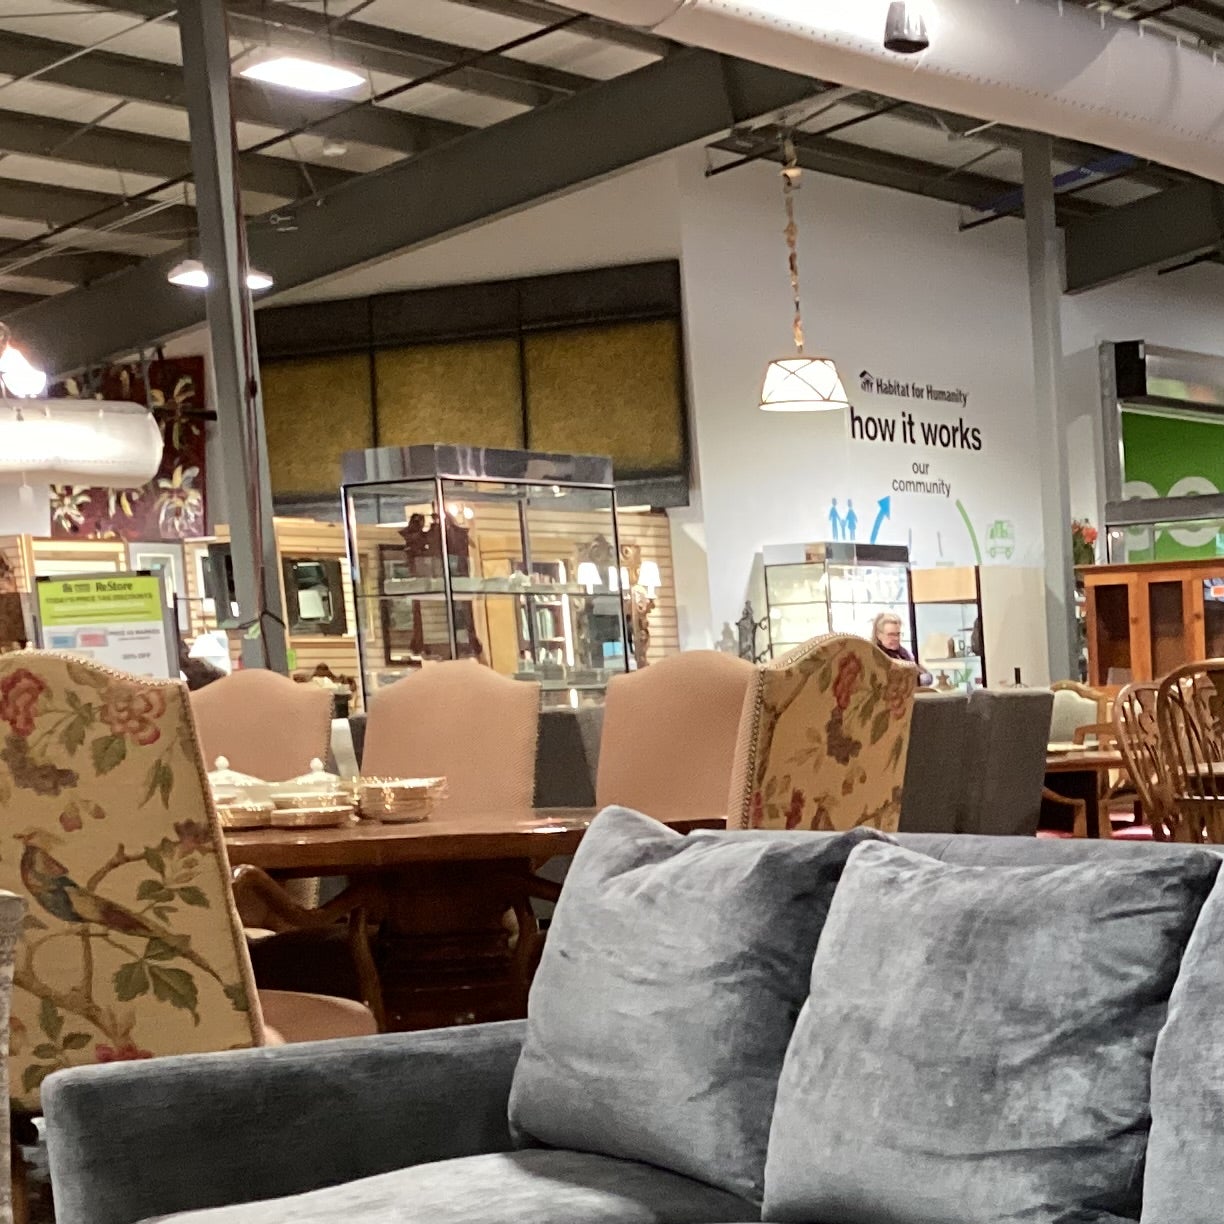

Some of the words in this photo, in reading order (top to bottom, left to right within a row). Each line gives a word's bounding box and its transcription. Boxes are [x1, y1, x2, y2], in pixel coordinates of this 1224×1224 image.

[876, 378, 909, 398] Habitat
[912, 382, 924, 399] for
[926, 384, 968, 408] Humanity
[850, 406, 896, 442] how
[902, 411, 916, 444] it
[920, 417, 982, 450] works
[912, 462, 929, 475] our
[892, 479, 951, 498] community
[95, 582, 133, 593] ReStore
